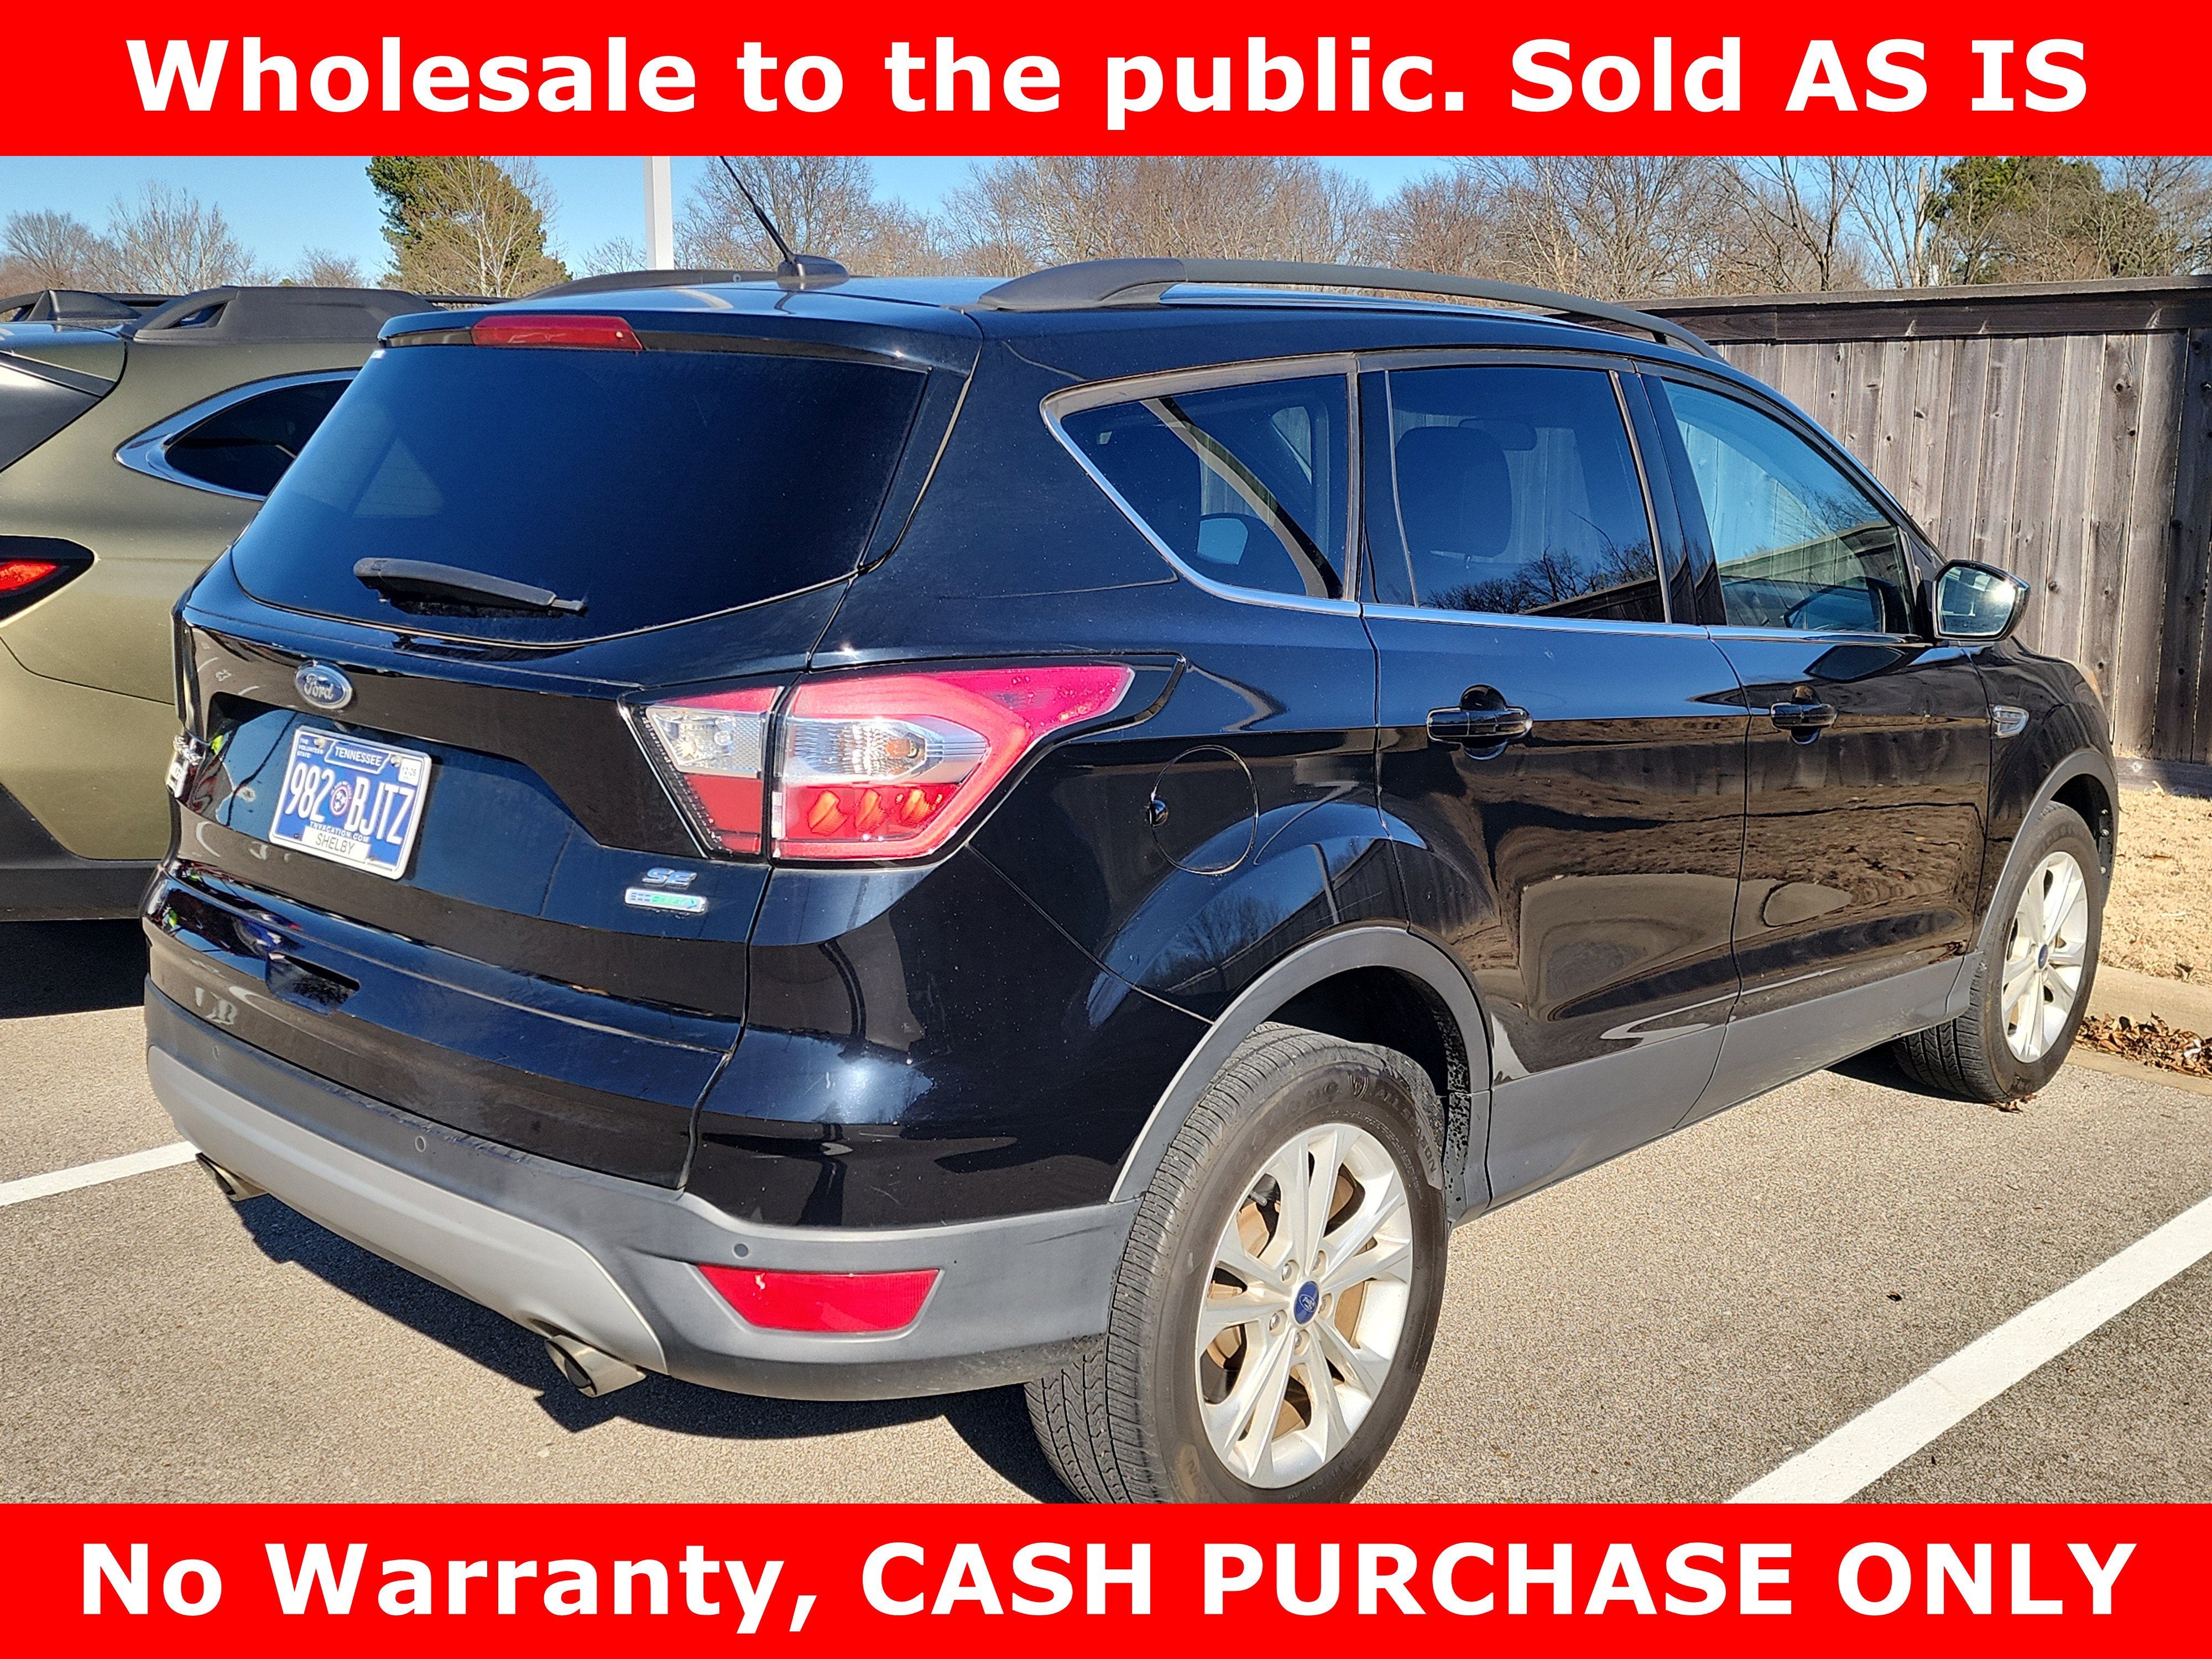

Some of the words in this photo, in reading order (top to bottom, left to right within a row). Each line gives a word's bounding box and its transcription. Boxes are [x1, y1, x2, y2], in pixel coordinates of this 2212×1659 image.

[304, 673, 334, 700] Ford
[335, 746, 383, 767] TENNESSEE
[284, 763, 336, 823] 982
[343, 776, 415, 845] BJTZ
[309, 822, 370, 843] TNVACATION.COM
[315, 833, 356, 855] SHELBY
[641, 867, 698, 888] SE
